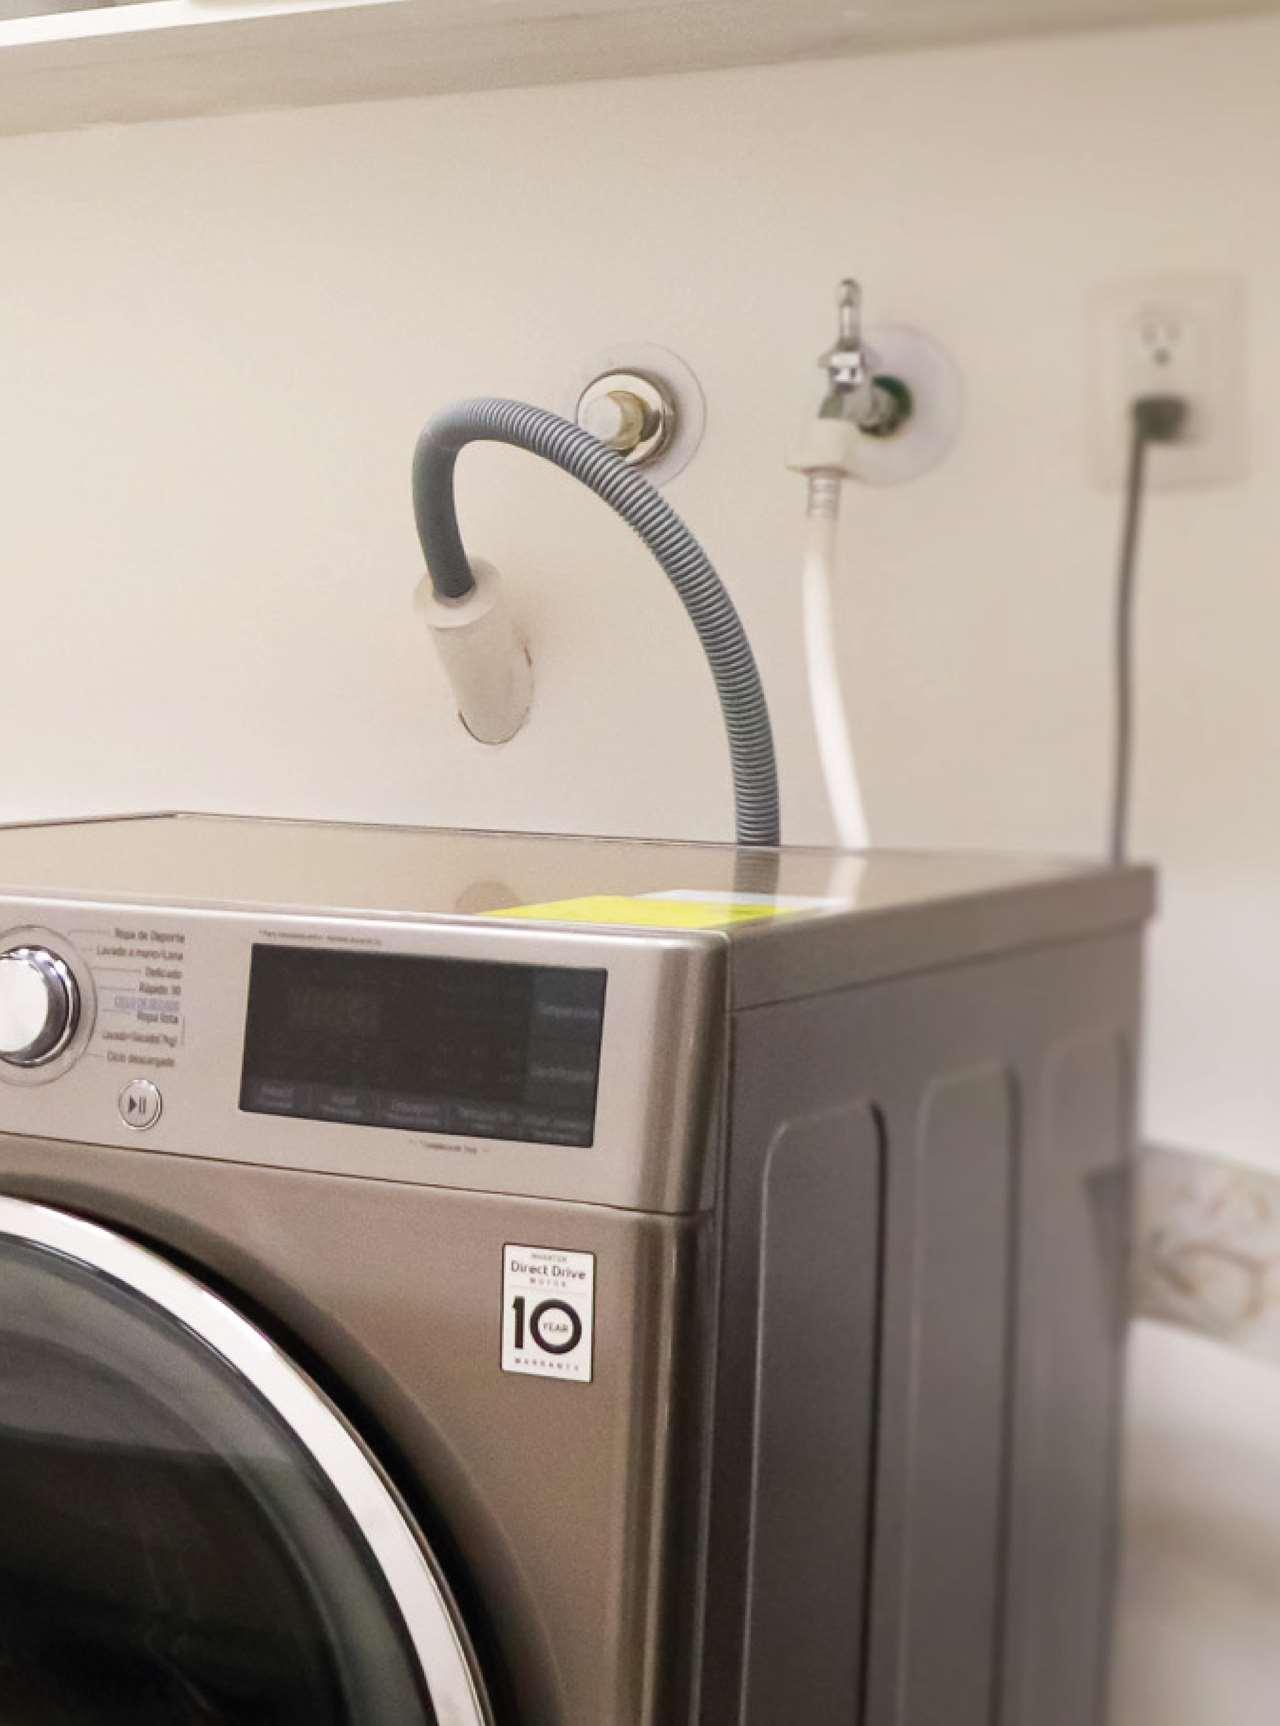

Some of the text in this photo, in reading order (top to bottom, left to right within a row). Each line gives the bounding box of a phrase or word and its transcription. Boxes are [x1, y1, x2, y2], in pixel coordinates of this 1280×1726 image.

[510, 1260, 587, 1280] Direct Drive
[511, 1295, 583, 1355] 10
